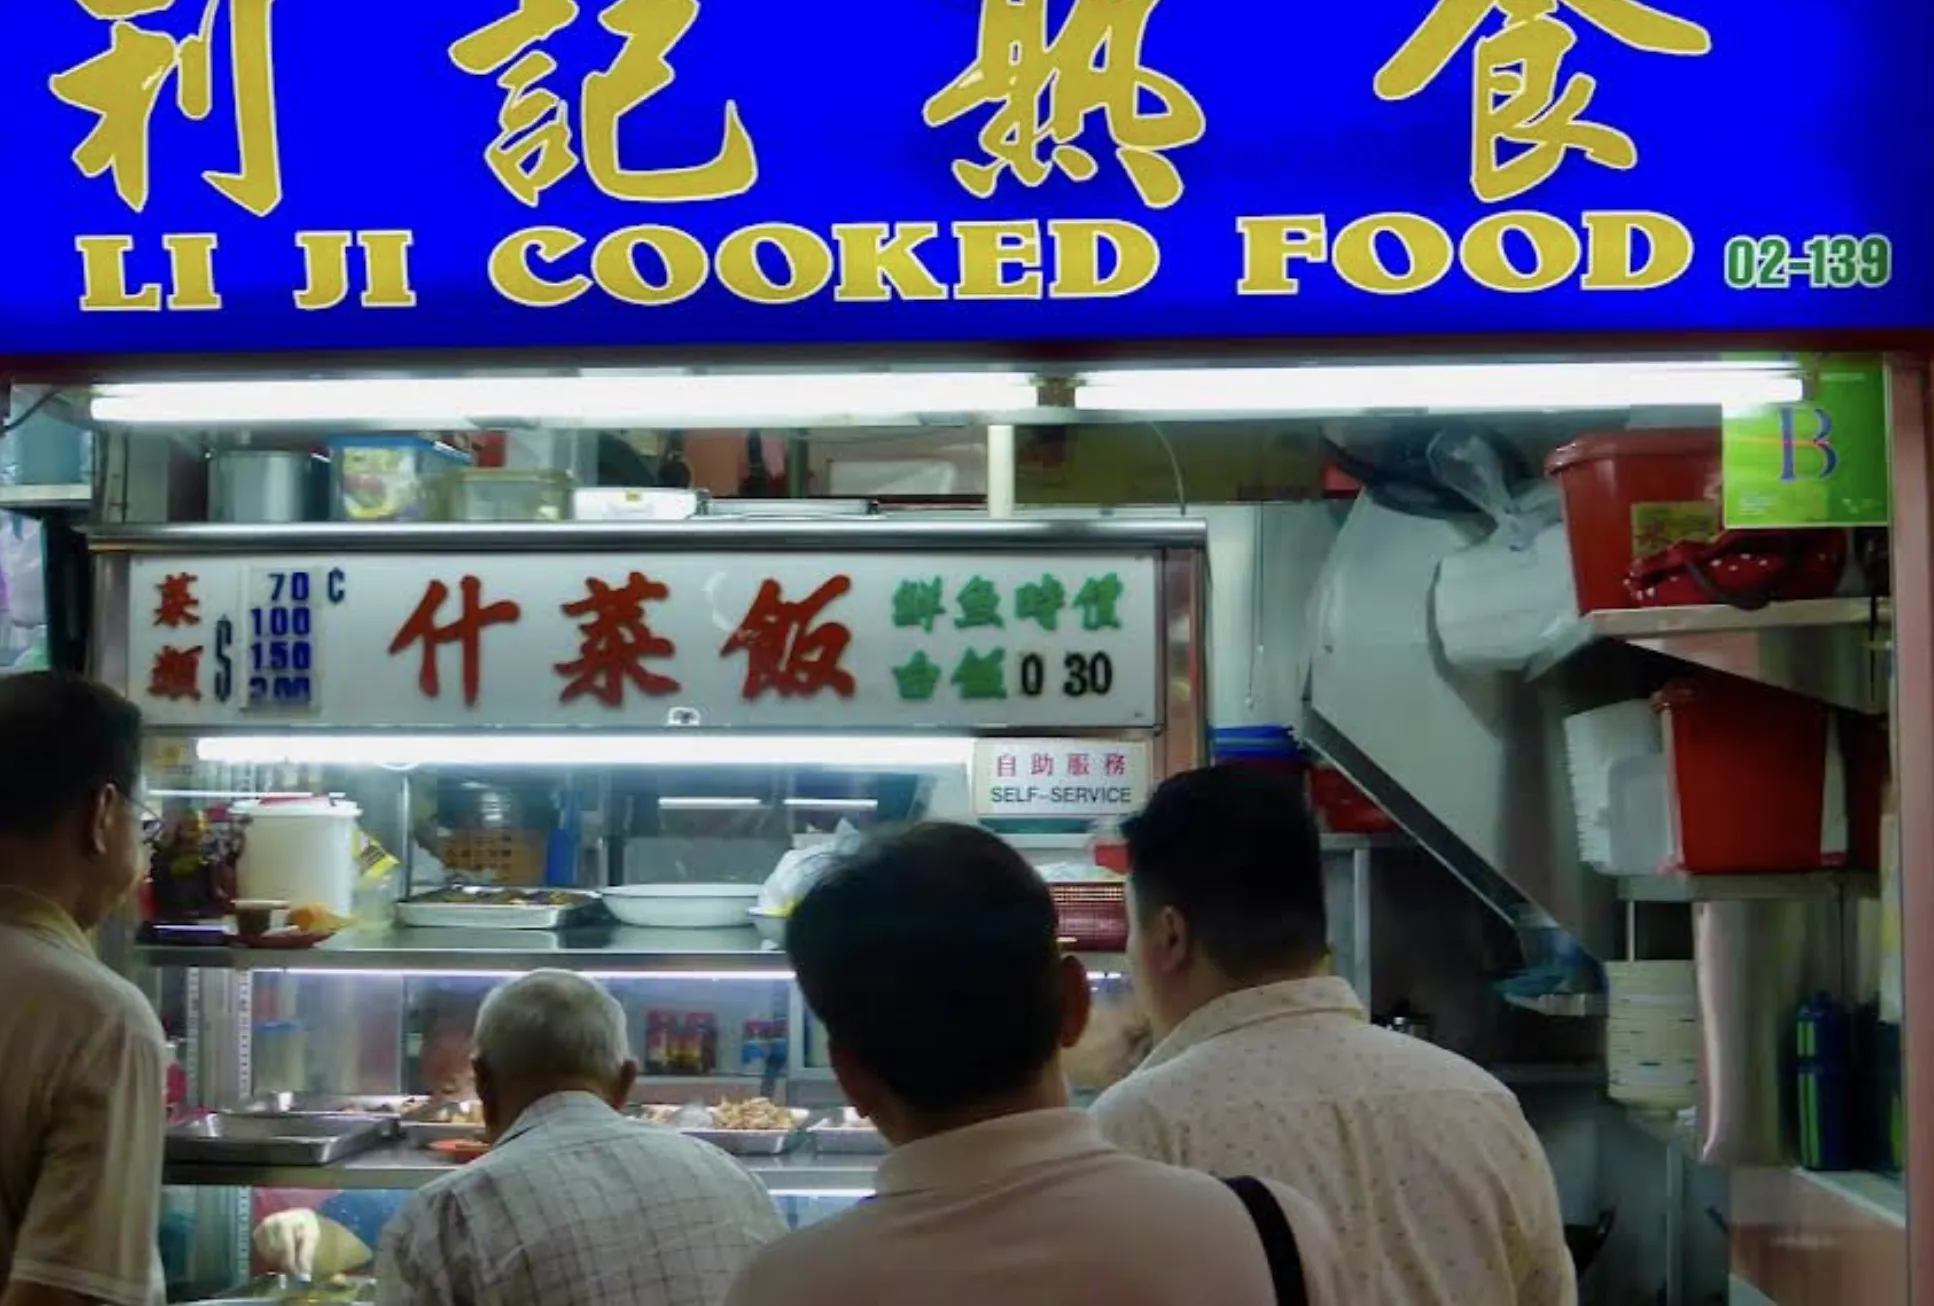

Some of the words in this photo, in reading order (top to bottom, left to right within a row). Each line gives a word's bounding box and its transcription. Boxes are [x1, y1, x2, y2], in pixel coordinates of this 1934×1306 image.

[75, 233, 222, 311] LI
[294, 229, 417, 310] JI
[487, 218, 1161, 305] COOKED
[1235, 210, 1695, 296] FOOD
[1723, 234, 1892, 289] 02-139
[1779, 403, 1839, 482] B
[268, 571, 310, 602] 70
[250, 606, 311, 636] 100
[388, 571, 857, 709] 什菜飯
[250, 641, 311, 671] 150
[1019, 652, 1045, 697] 0
[1062, 651, 1113, 697] 30
[997, 752, 1127, 778] 自助服務
[990, 786, 1132, 804] SELF-SERVICE
